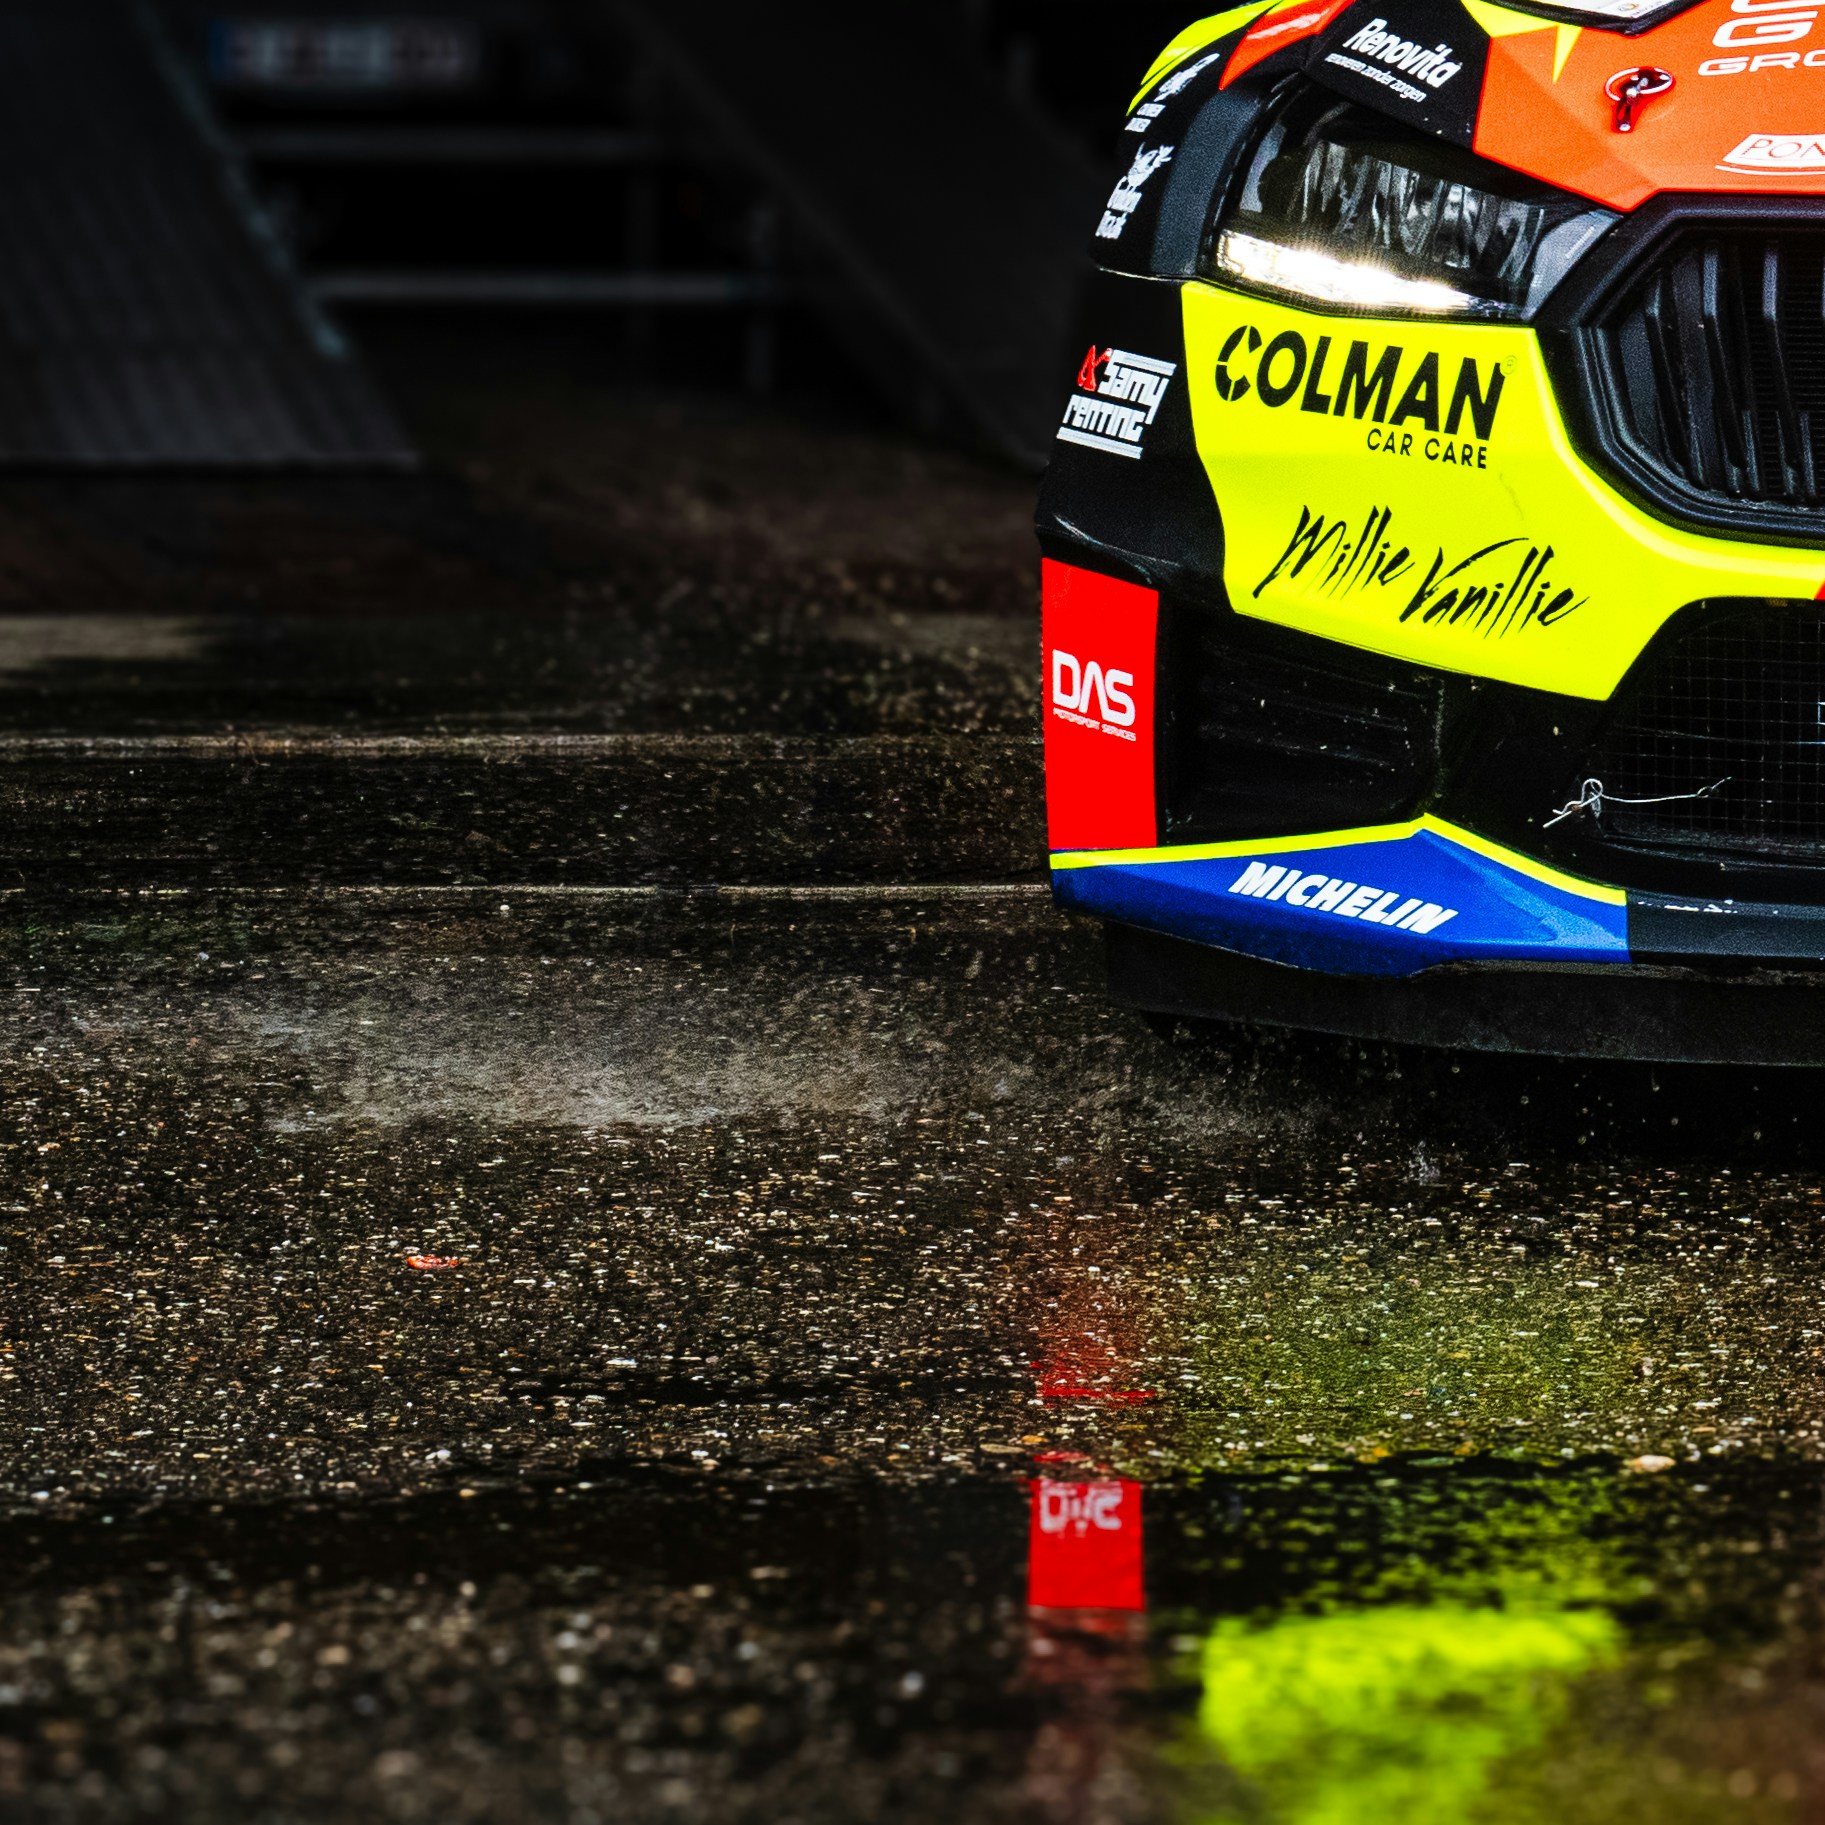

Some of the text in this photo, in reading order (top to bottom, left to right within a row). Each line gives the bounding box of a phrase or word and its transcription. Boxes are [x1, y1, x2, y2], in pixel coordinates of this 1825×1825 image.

[1342, 17, 1463, 89] Renovita
[1213, 323, 1504, 442] COLMAN
[1366, 427, 1489, 470] CAR CARE
[1253, 503, 1591, 641] Millie Vanillie
[1052, 648, 1136, 727] DAS
[1228, 862, 1459, 936] MICHELIN
